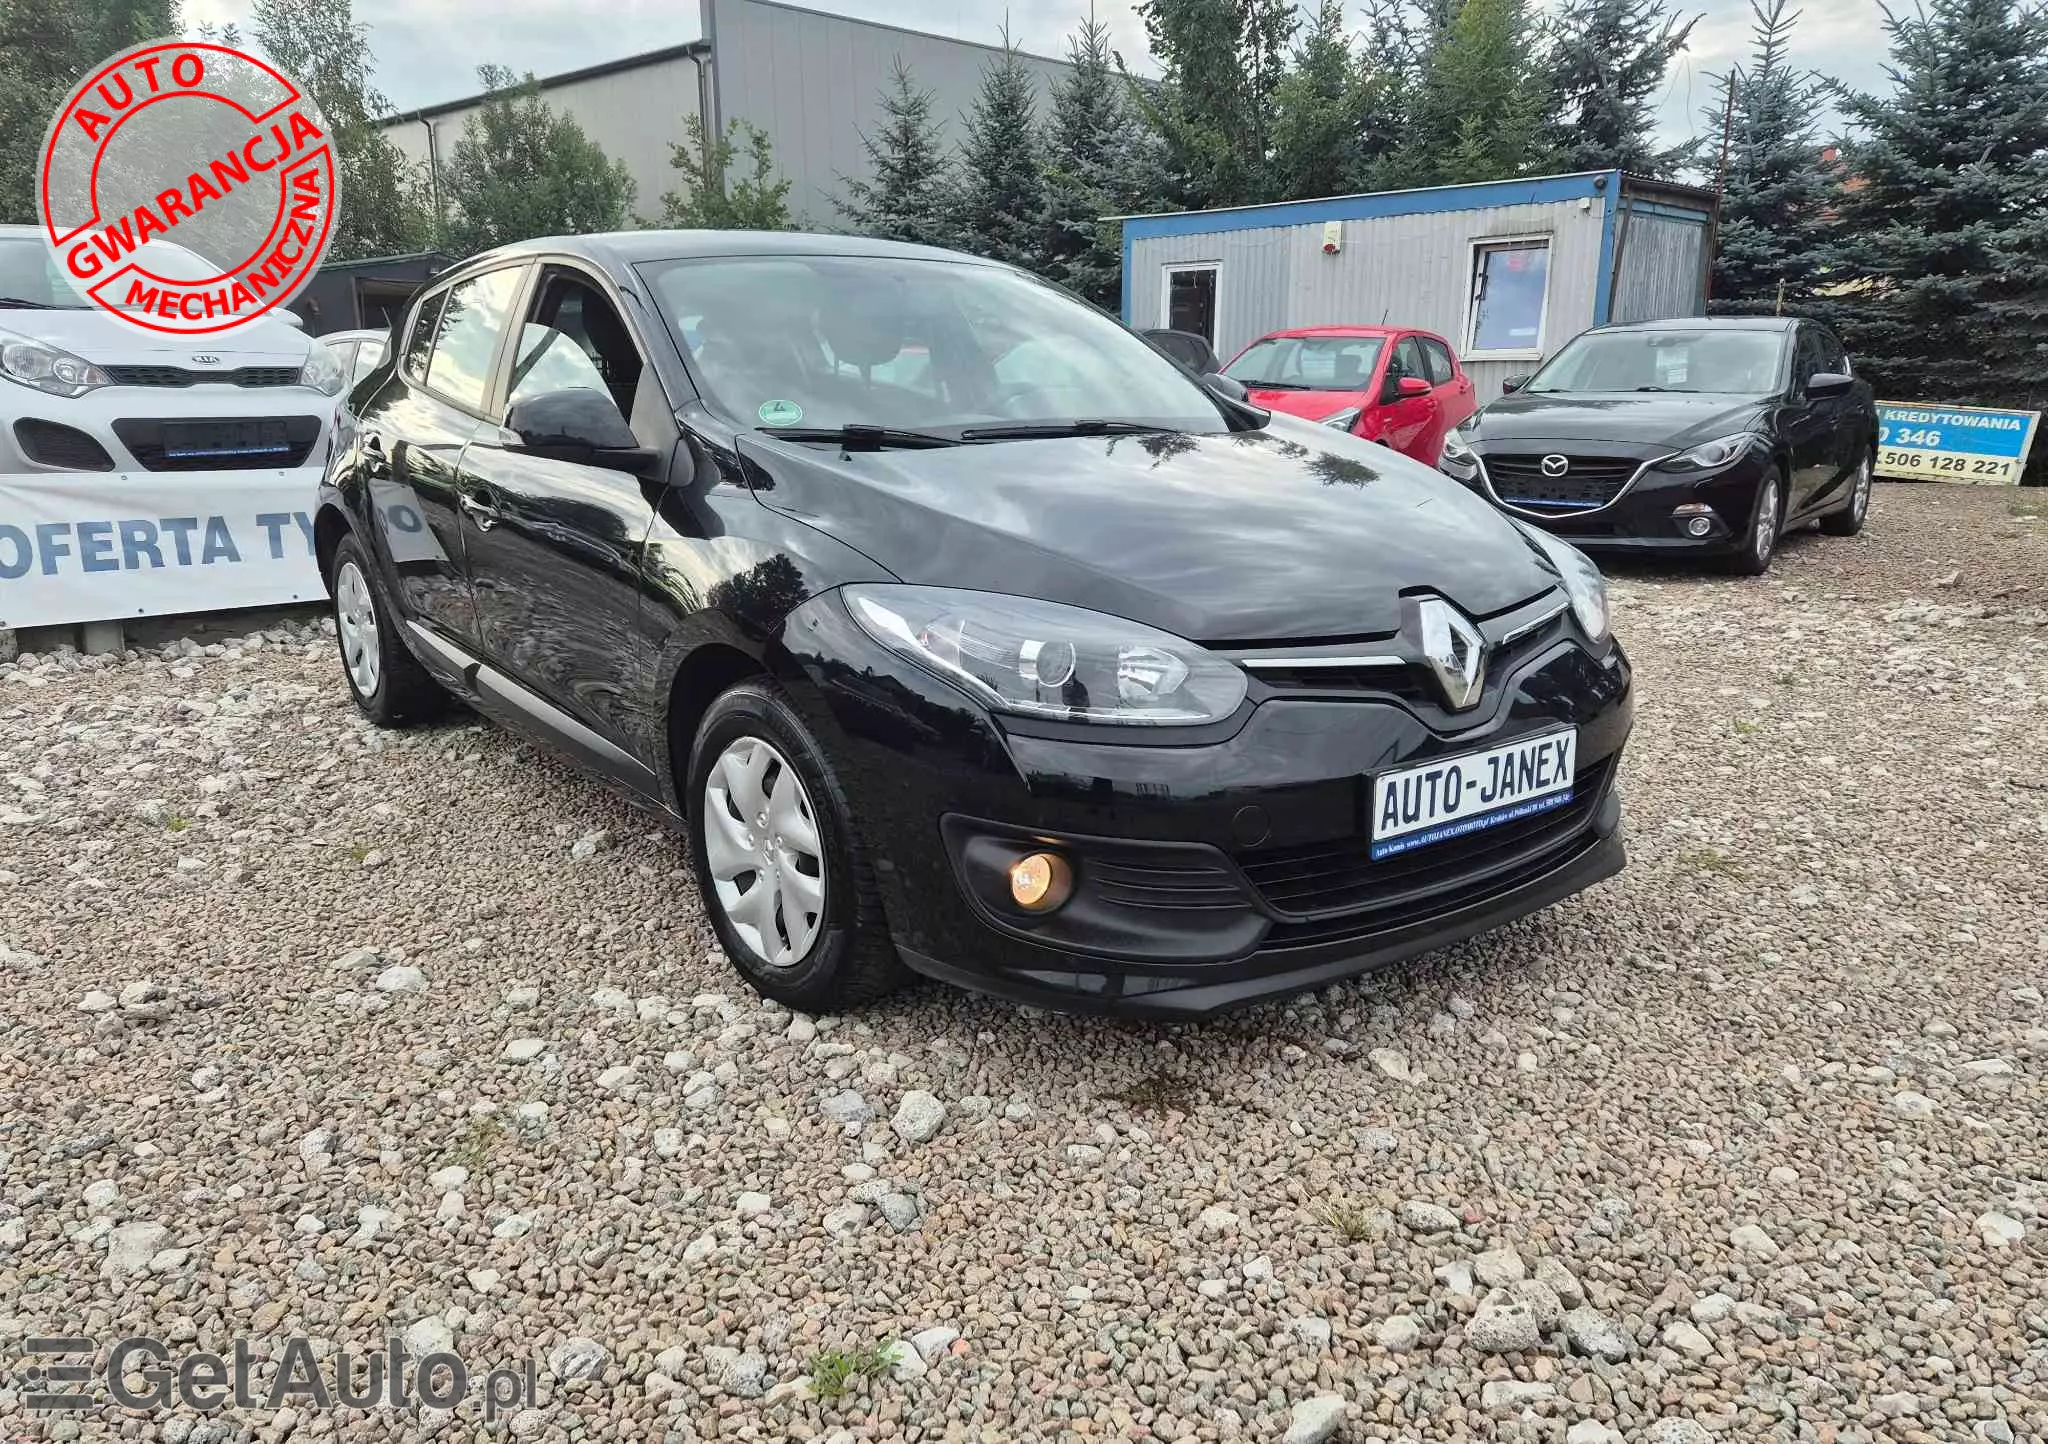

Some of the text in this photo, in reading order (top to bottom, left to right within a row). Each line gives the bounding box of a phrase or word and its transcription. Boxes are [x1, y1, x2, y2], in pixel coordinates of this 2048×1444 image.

[1883, 409, 2021, 431] KREDYTOWANIA
[1896, 427, 1941, 447] 346
[1885, 452, 1922, 468] 506
[1929, 455, 1966, 472] 128
[1972, 460, 2010, 477] 221
[0, 514, 242, 580] OFERTA
[1381, 737, 1570, 831] AUTO-JANEX
